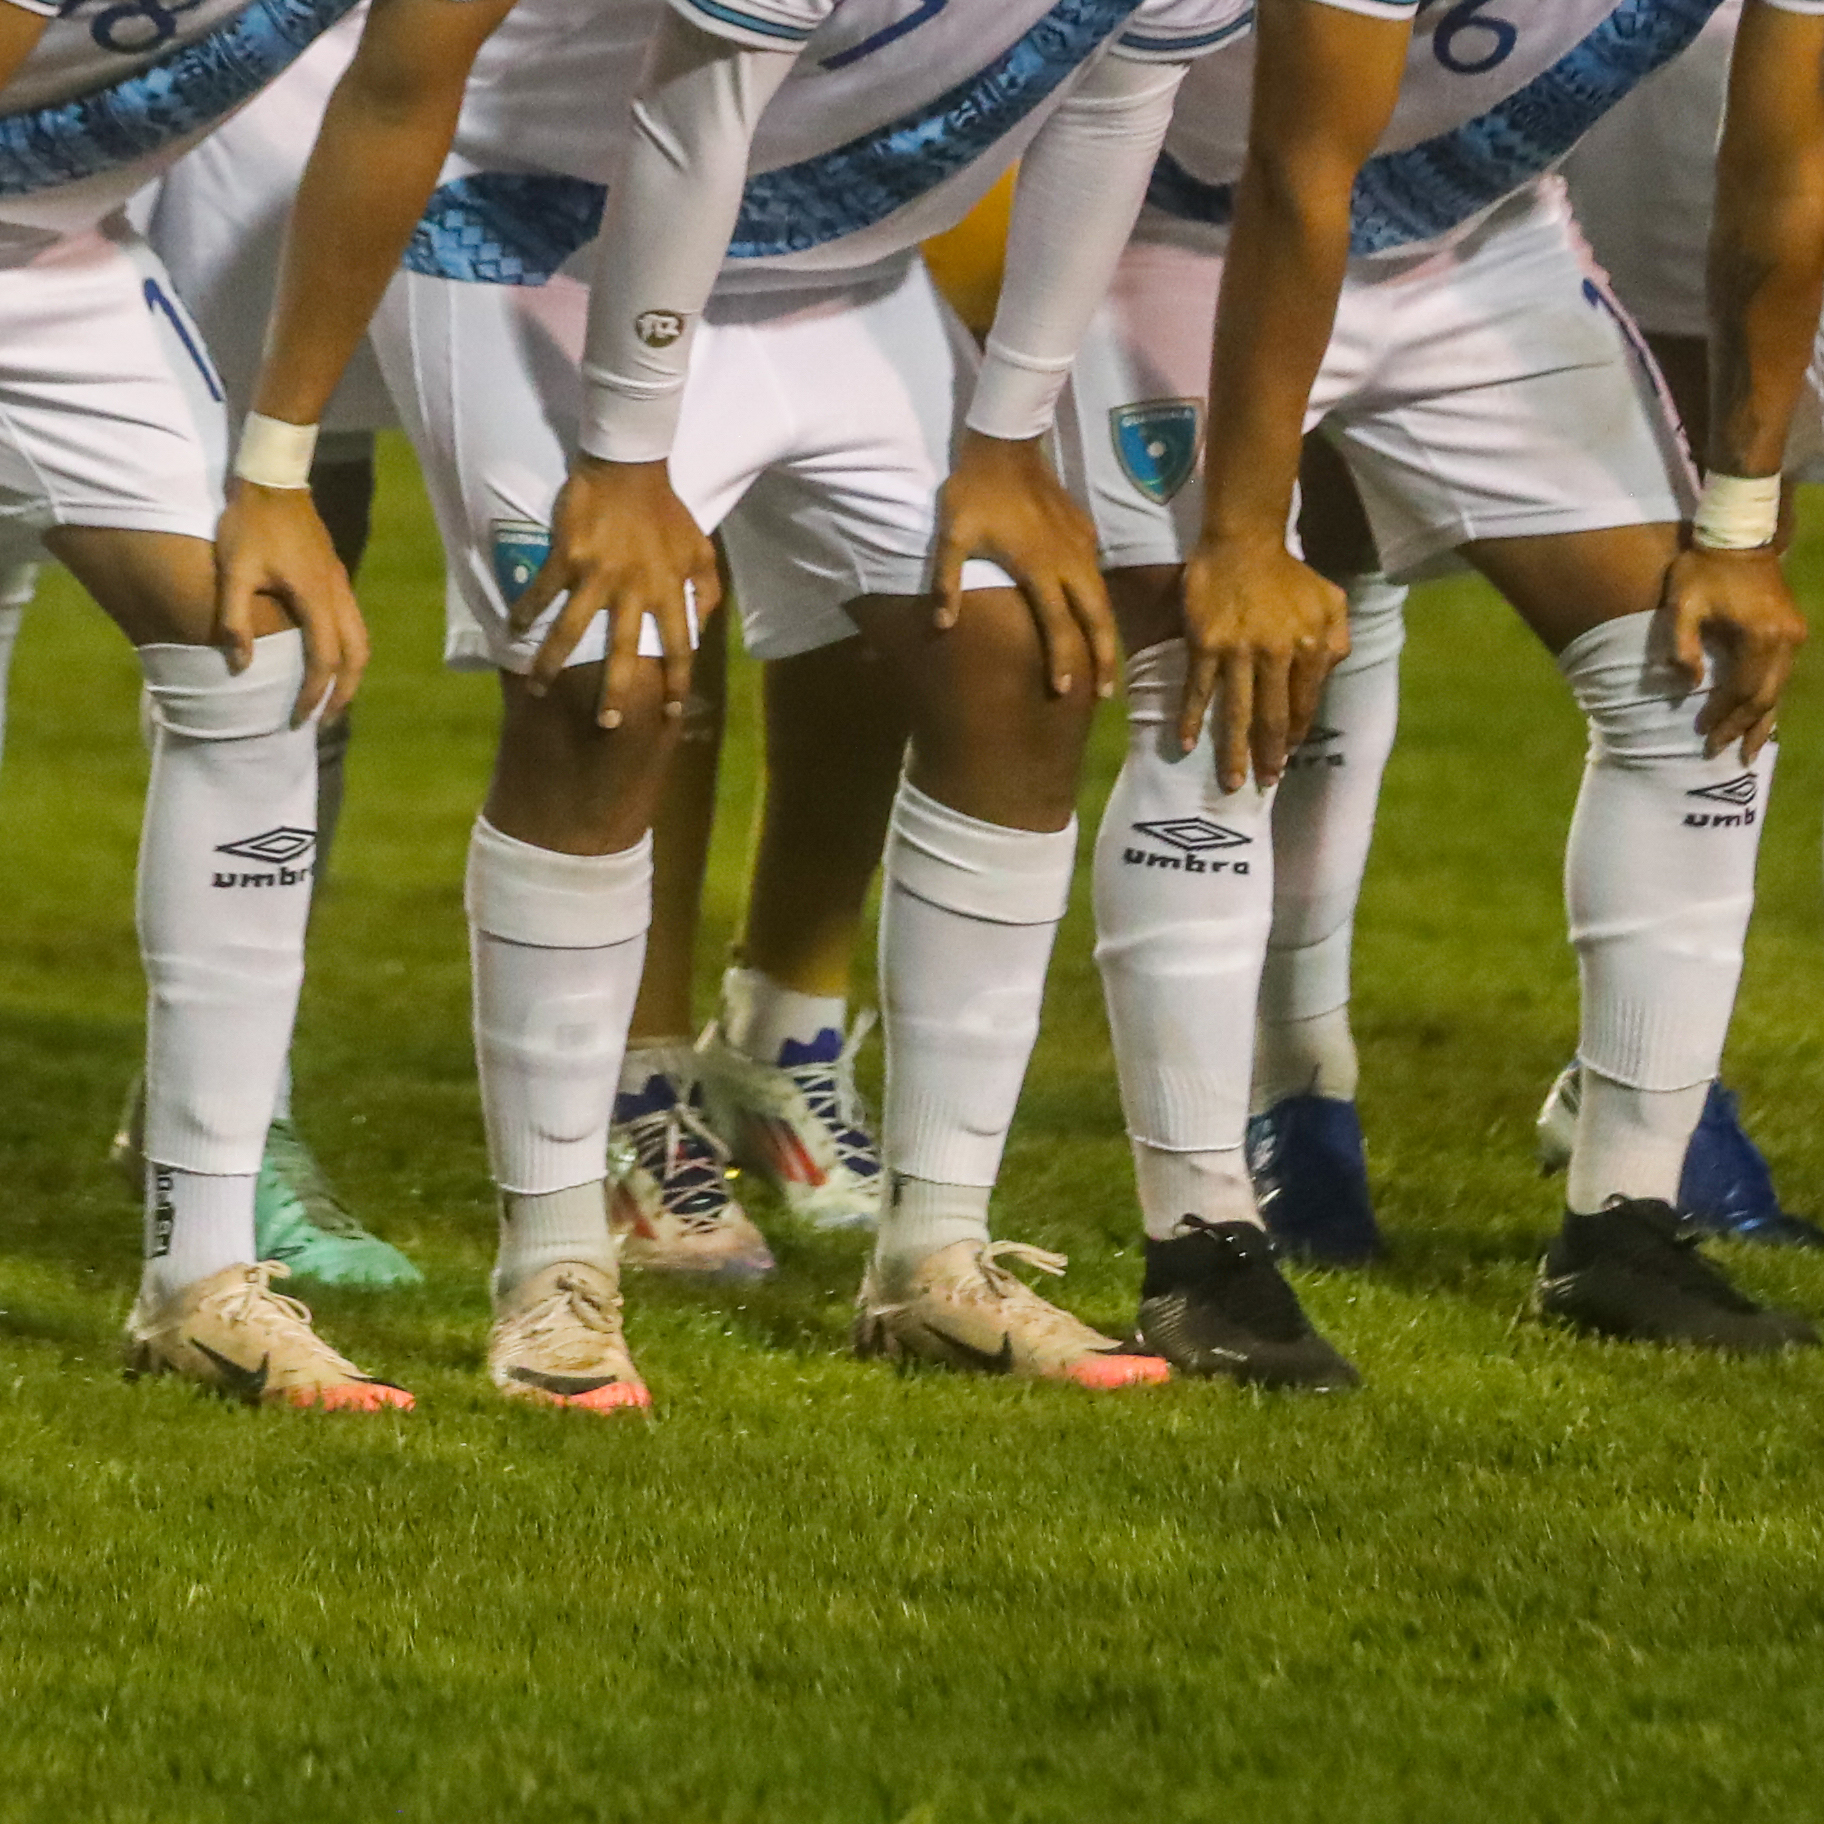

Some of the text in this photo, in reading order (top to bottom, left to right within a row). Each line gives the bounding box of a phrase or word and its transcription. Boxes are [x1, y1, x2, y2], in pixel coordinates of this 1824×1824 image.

[1682, 807, 1757, 828] umb
[1124, 846, 1251, 875] umbro
[211, 866, 309, 888] umbr
